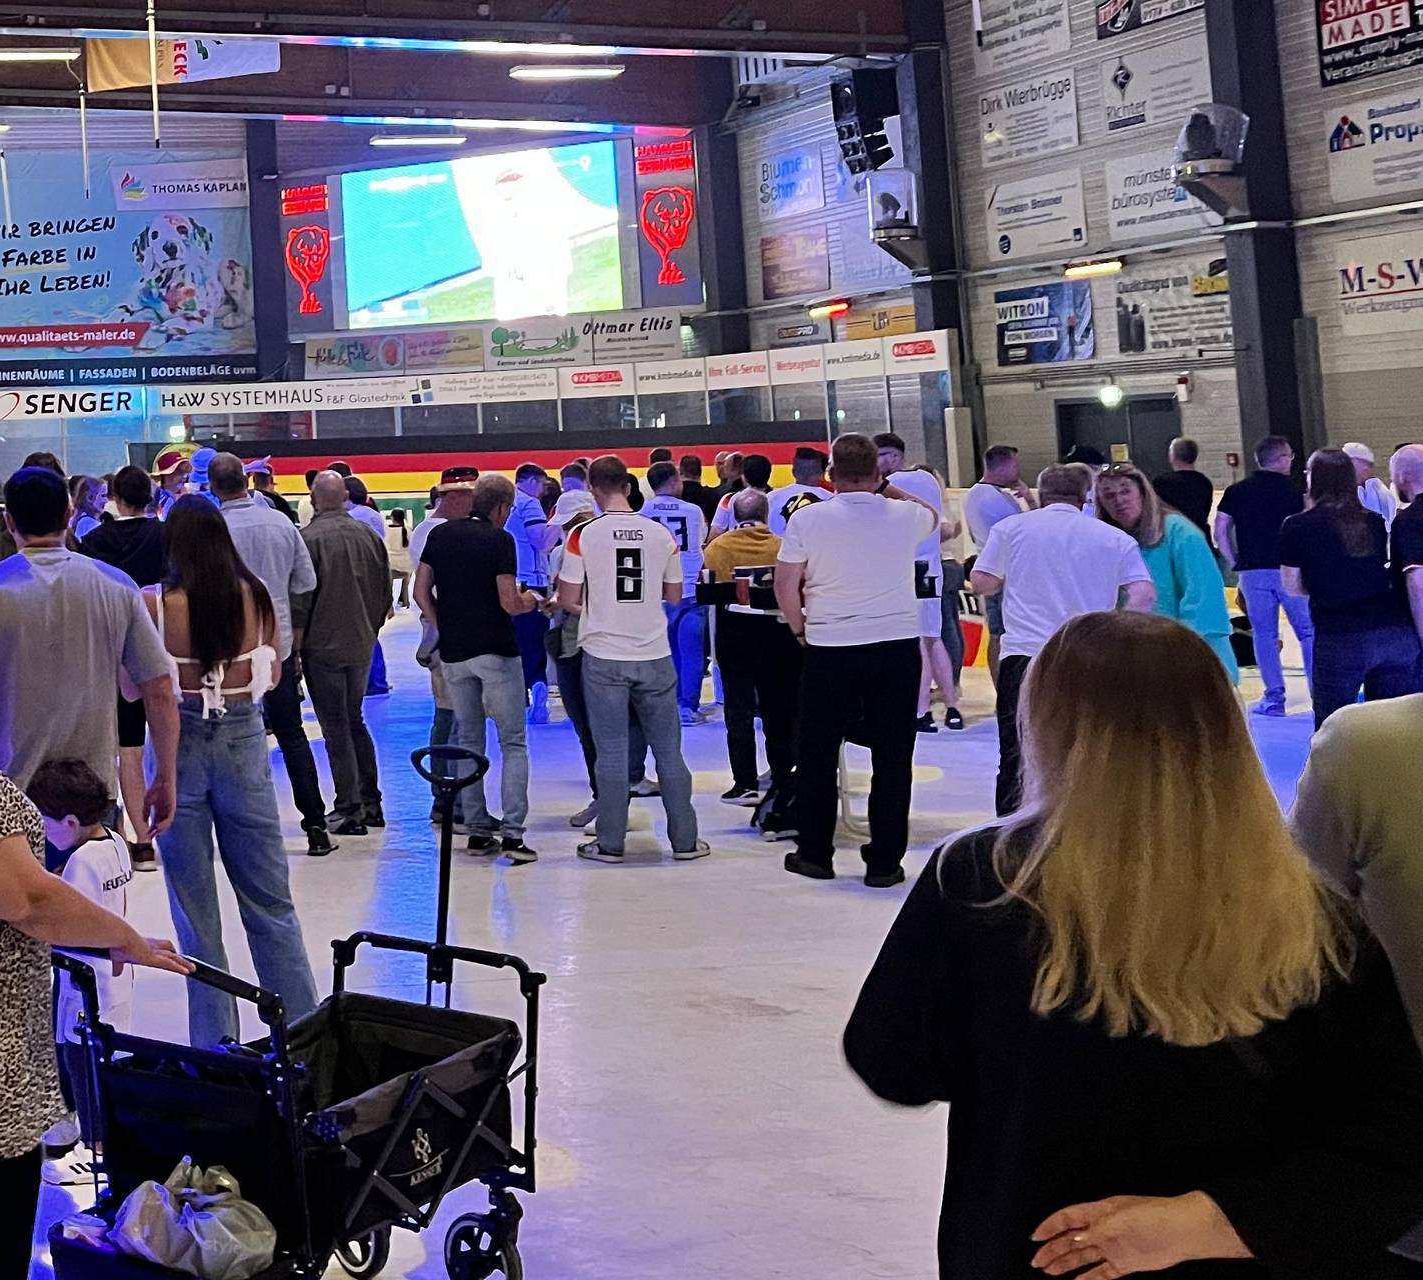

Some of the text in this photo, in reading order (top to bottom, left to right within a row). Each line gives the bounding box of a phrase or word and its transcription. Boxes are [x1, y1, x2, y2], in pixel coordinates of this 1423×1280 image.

[1328, 6, 1403, 45] MADE
[152, 182, 247, 194] THOMAS KAPLAN
[29, 216, 116, 237] BRINGEN
[1, 245, 96, 268] FARBE IN
[40, 270, 111, 293] LEBEN!
[997, 303, 1044, 319] WITRON
[582, 319, 635, 337] Ottmar
[79, 367, 137, 380] FASSADEN
[150, 365, 231, 378] BODENBELÄGE
[232, 367, 257, 376] uvm
[25, 391, 132, 415] SENGER
[161, 388, 325, 408] H&W SYSTEMHAUS
[613, 529, 644, 541] KROOS
[615, 548, 645, 603] 8
